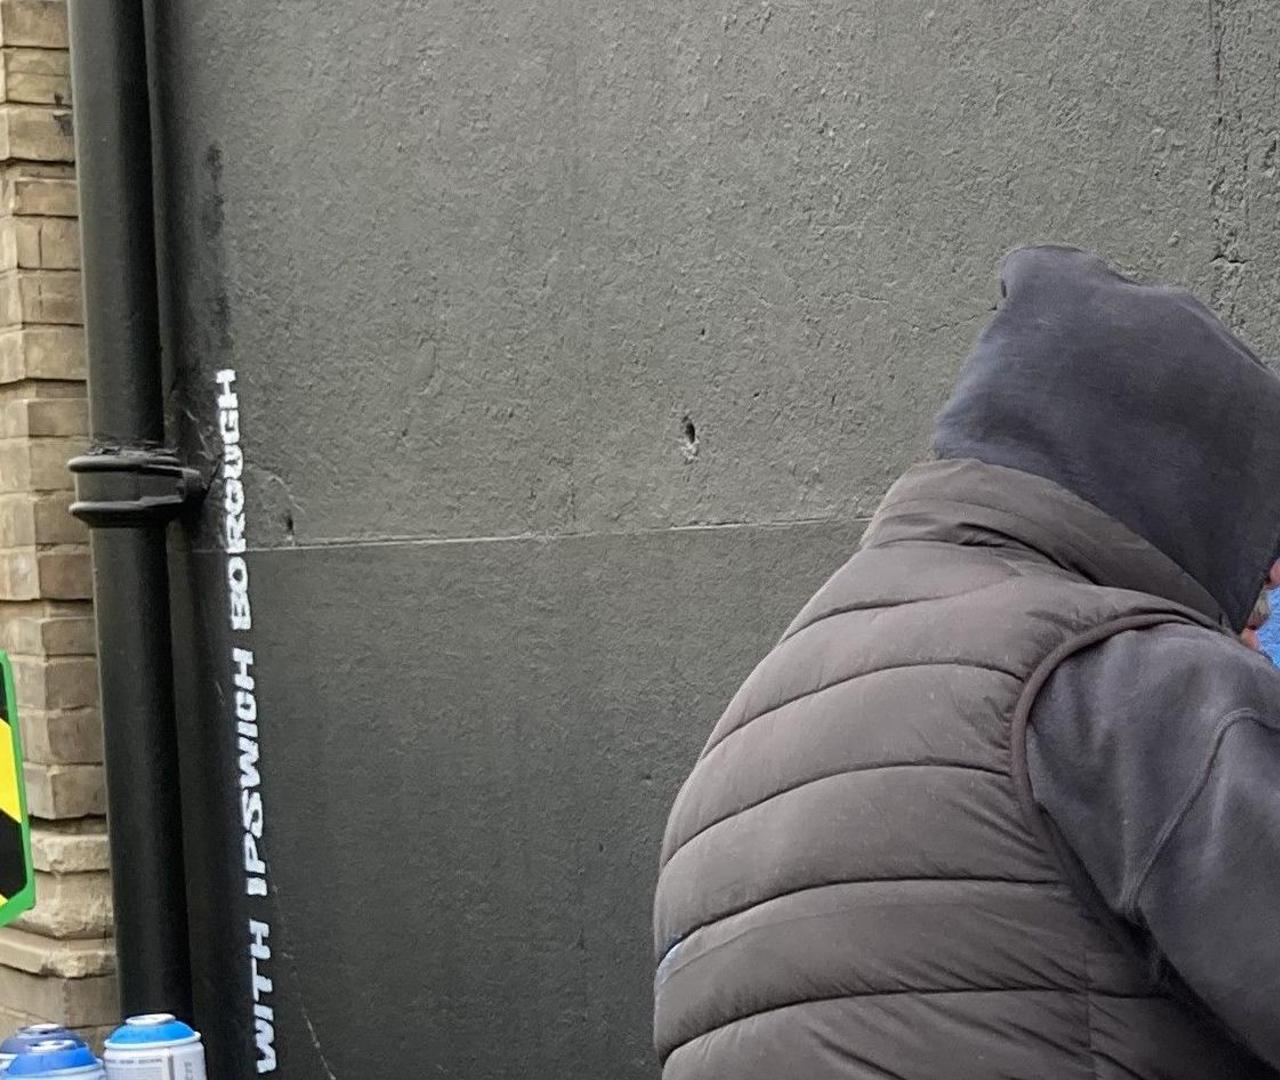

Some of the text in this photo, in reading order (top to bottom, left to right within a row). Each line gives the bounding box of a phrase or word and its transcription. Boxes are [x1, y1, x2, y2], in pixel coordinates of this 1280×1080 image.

[215, 368, 251, 630] BOROUGH
[233, 647, 268, 897] IPSWICH
[249, 918, 277, 1074] WITH
